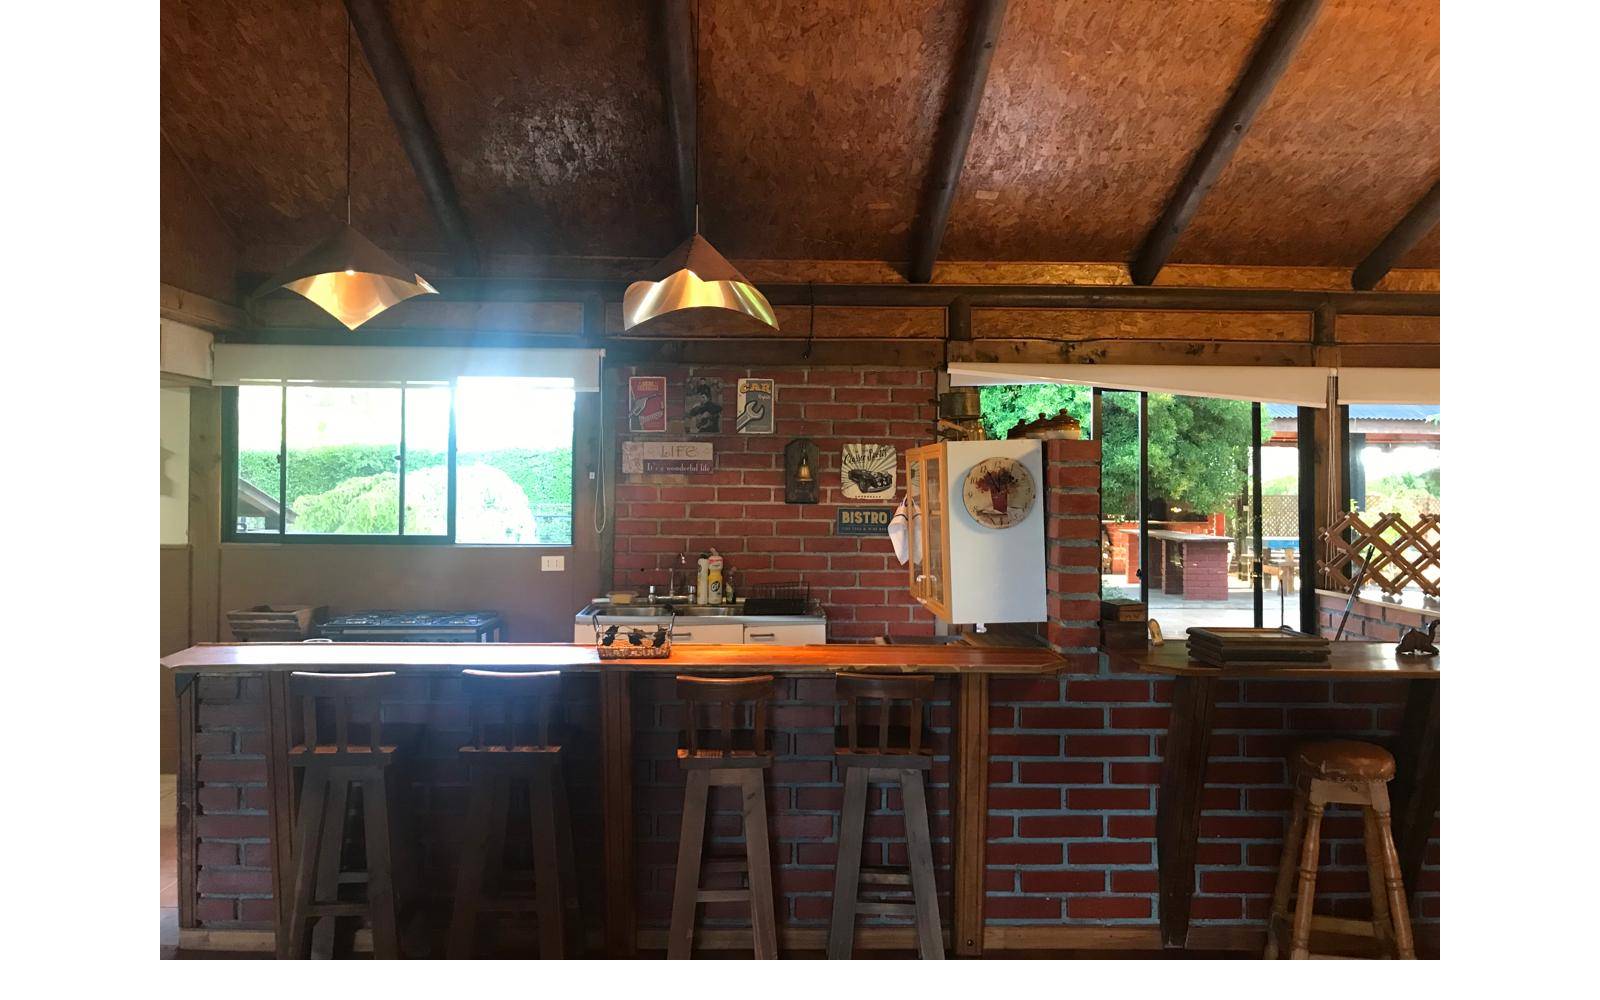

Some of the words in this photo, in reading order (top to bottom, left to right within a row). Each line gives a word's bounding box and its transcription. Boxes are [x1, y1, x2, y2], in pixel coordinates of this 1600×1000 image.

[740, 383, 771, 394] CAR
[666, 463, 698, 472] wonderful
[700, 463, 711, 472] life
[842, 511, 888, 524] BISTRO
